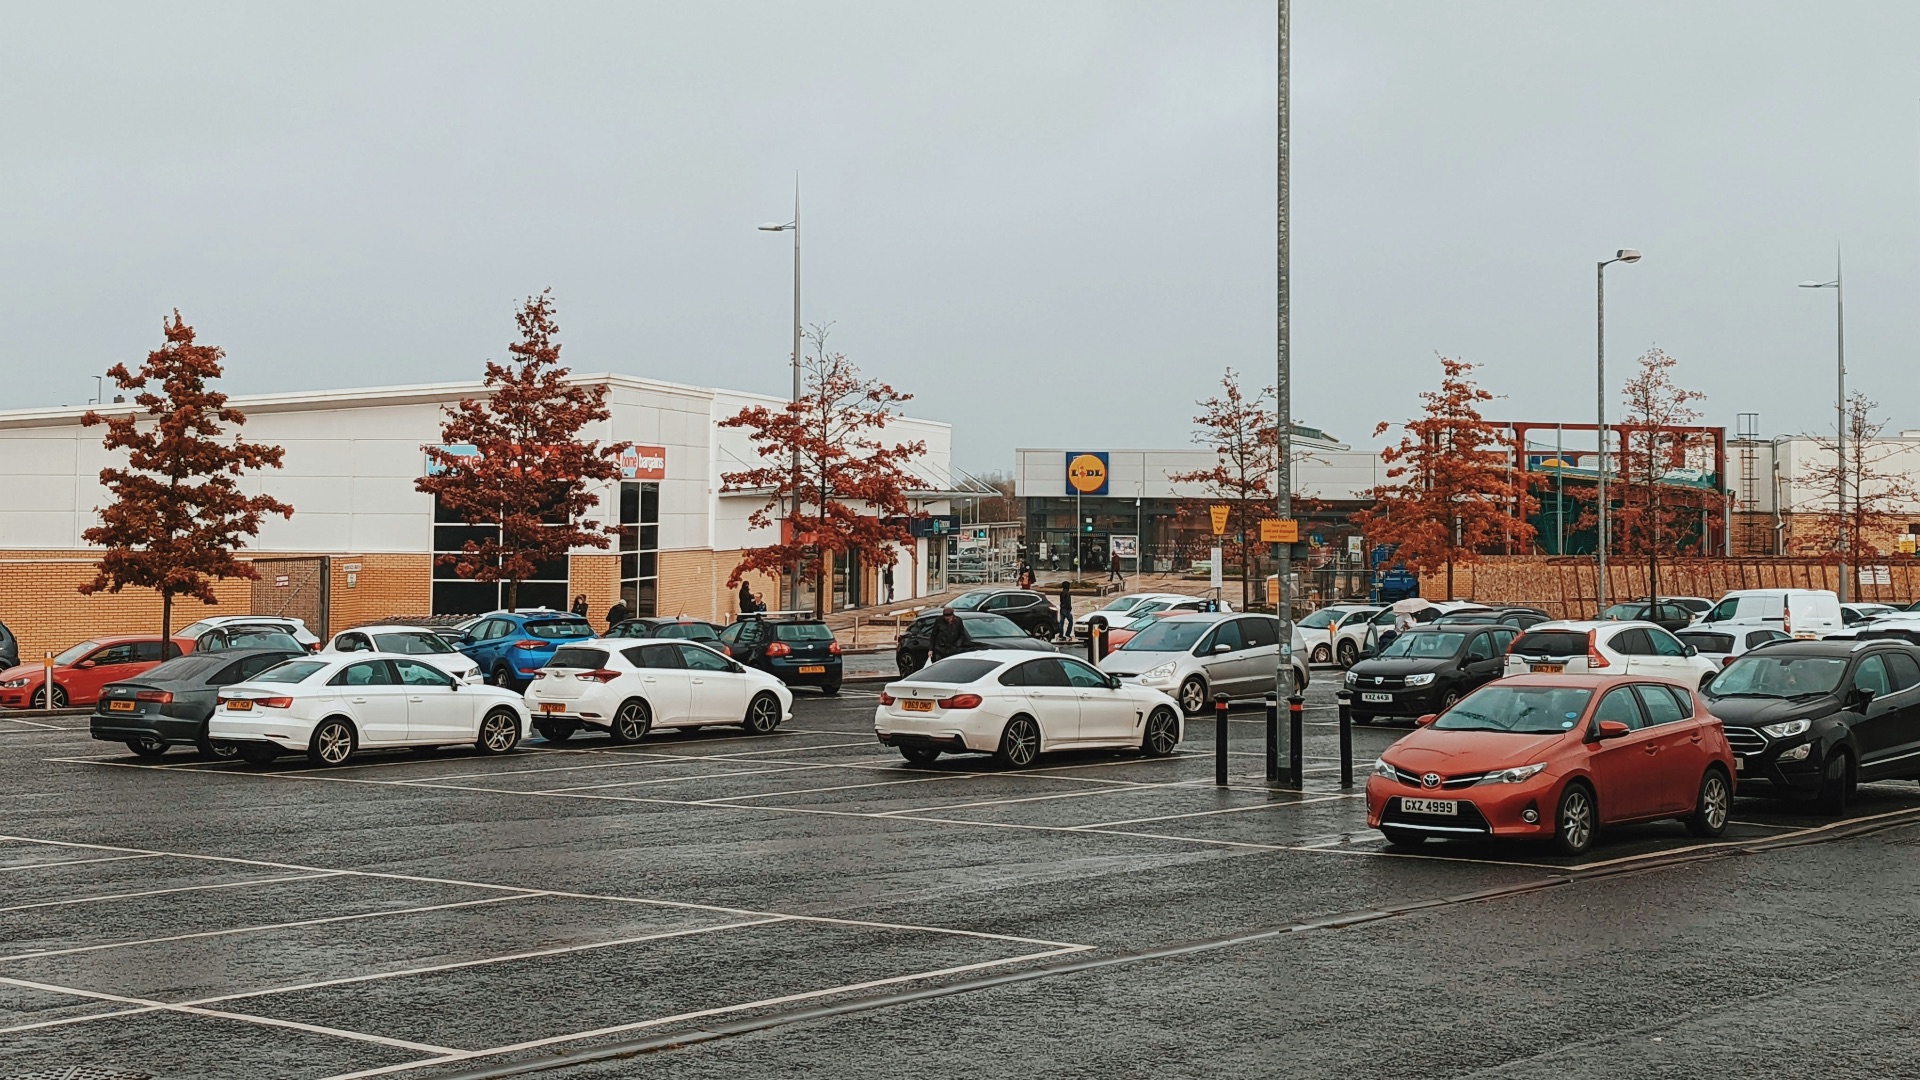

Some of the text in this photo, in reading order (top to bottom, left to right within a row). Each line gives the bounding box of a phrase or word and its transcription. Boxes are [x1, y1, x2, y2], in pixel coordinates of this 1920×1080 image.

[622, 455, 637, 468] home
[1071, 466, 1103, 478] LIDL
[1405, 800, 1453, 813] GXZ 4999
